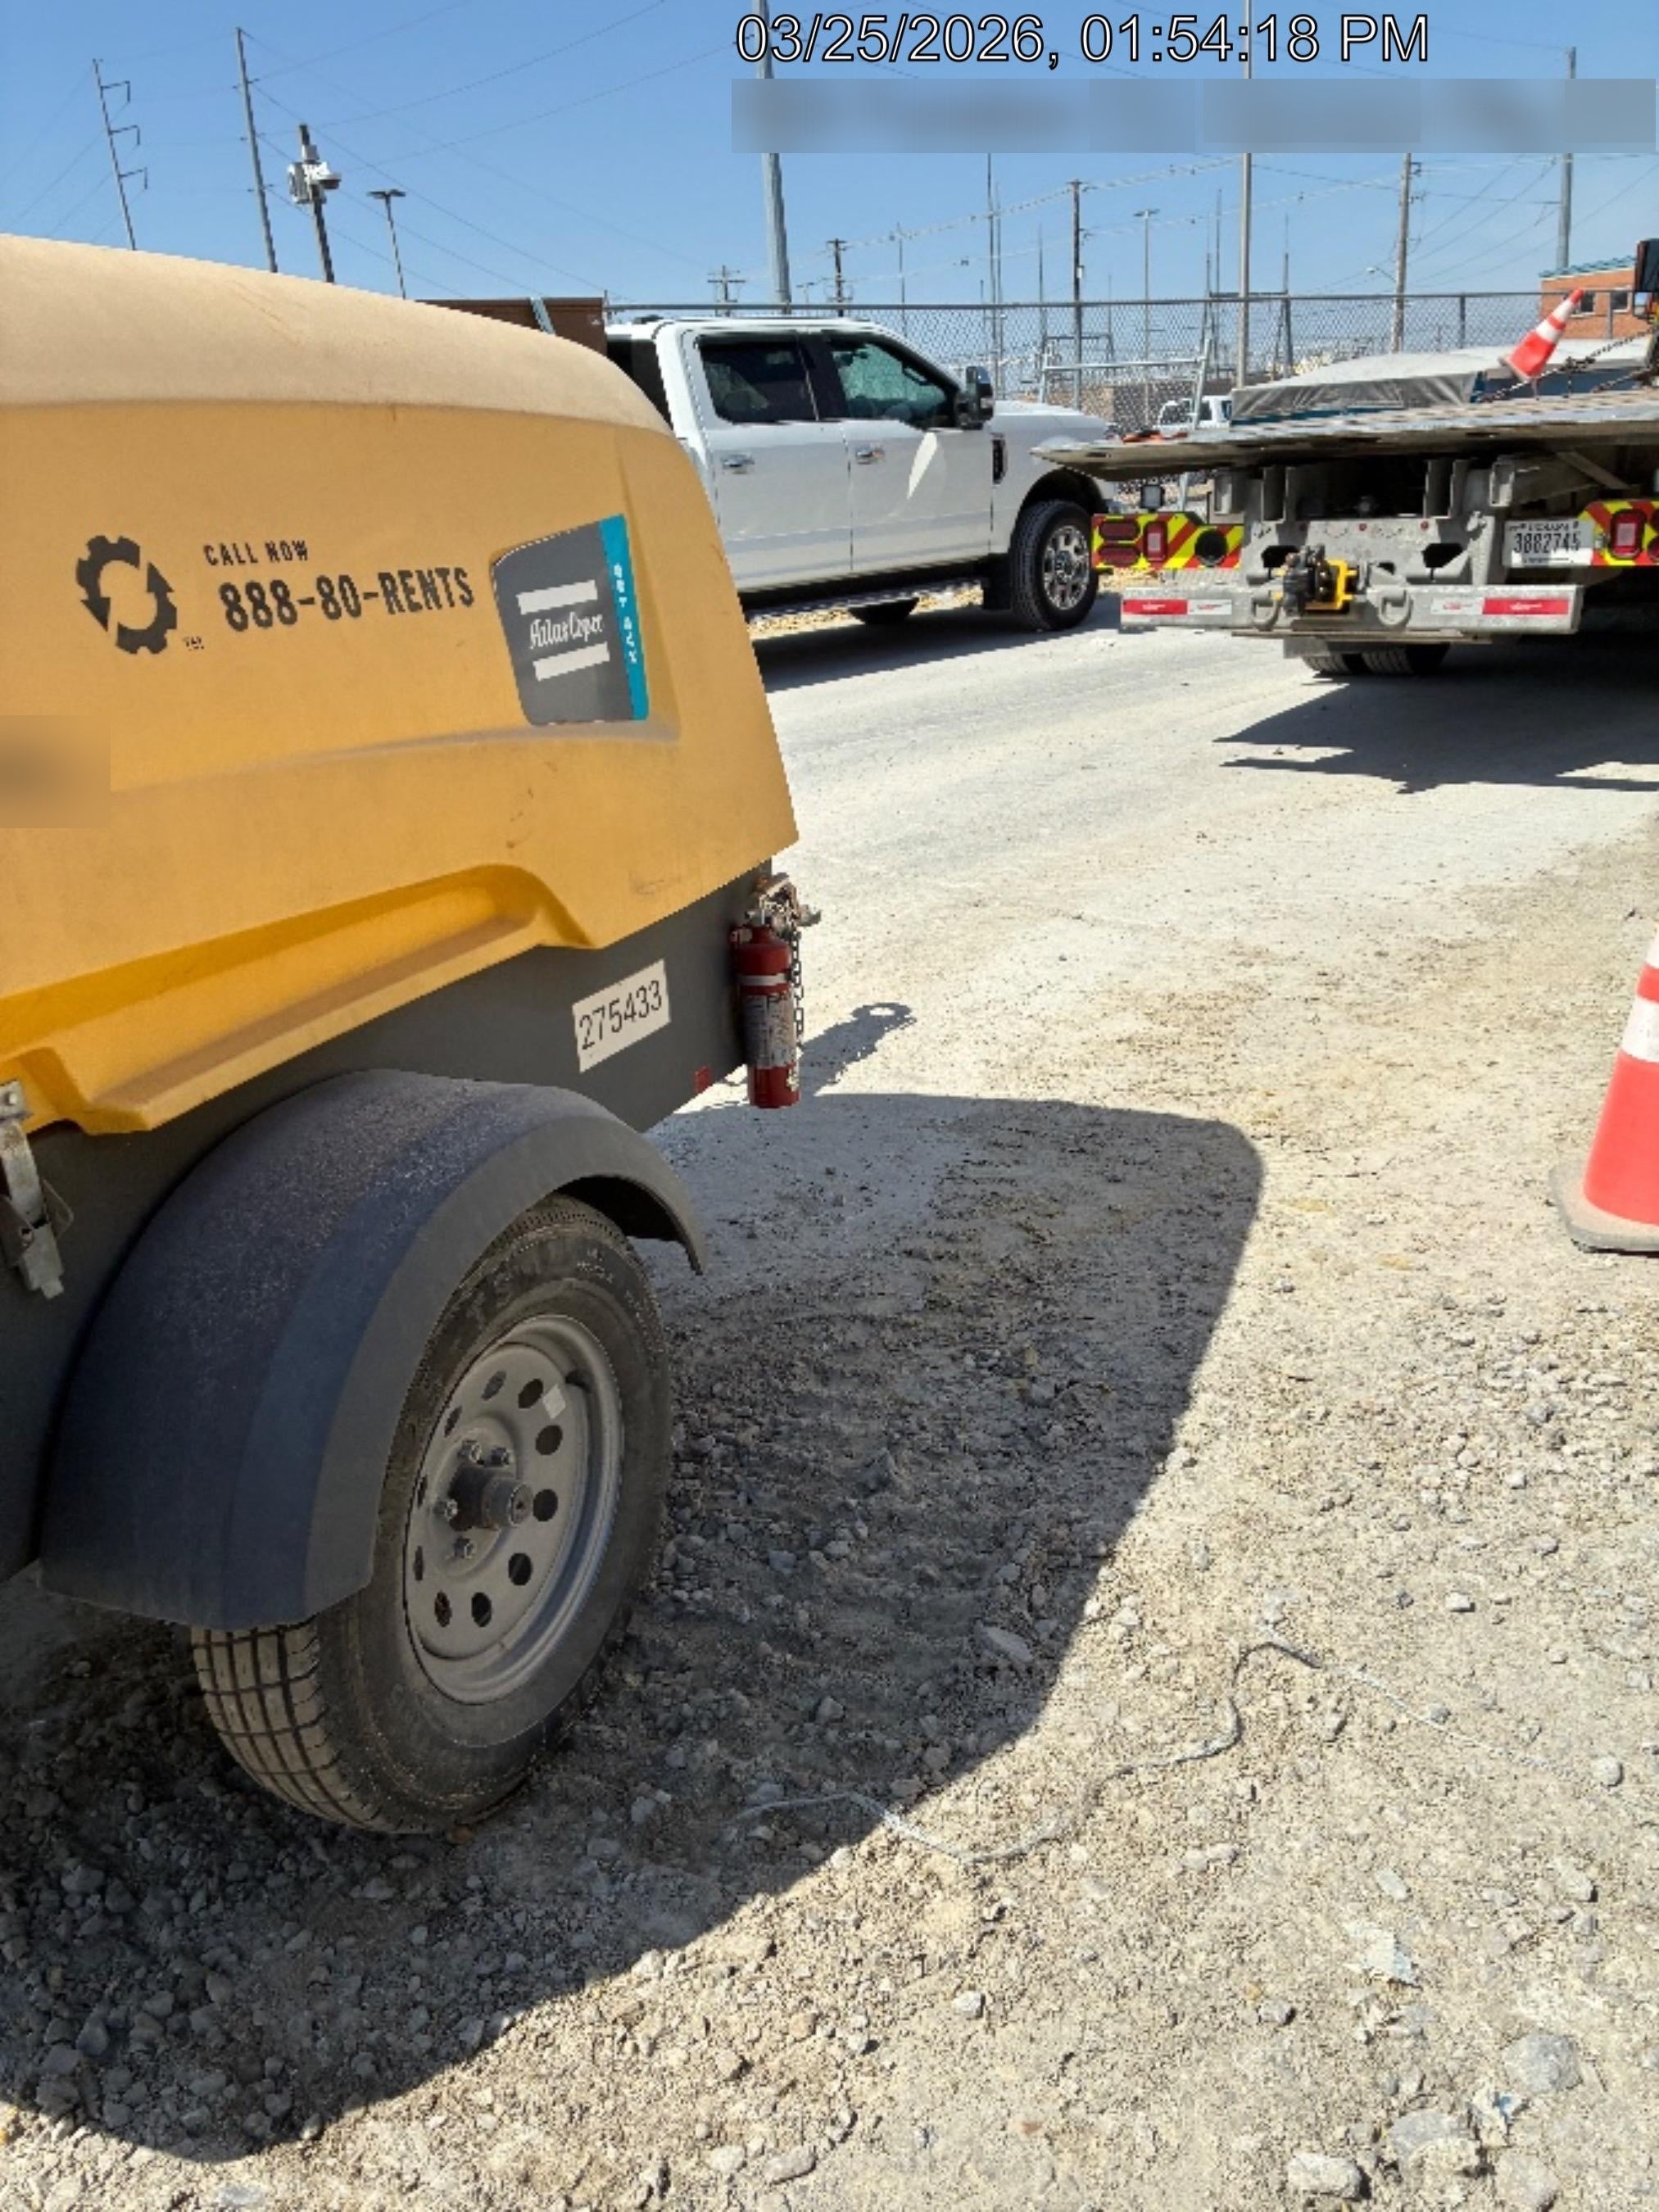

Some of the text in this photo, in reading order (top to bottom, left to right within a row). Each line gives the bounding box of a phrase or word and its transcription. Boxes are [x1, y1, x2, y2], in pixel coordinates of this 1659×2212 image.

[203, 540, 308, 566] CALL NOW
[219, 567, 474, 632] 888-80-RENTS
[529, 618, 569, 650] Atlas
[578, 980, 662, 1049] 275433
